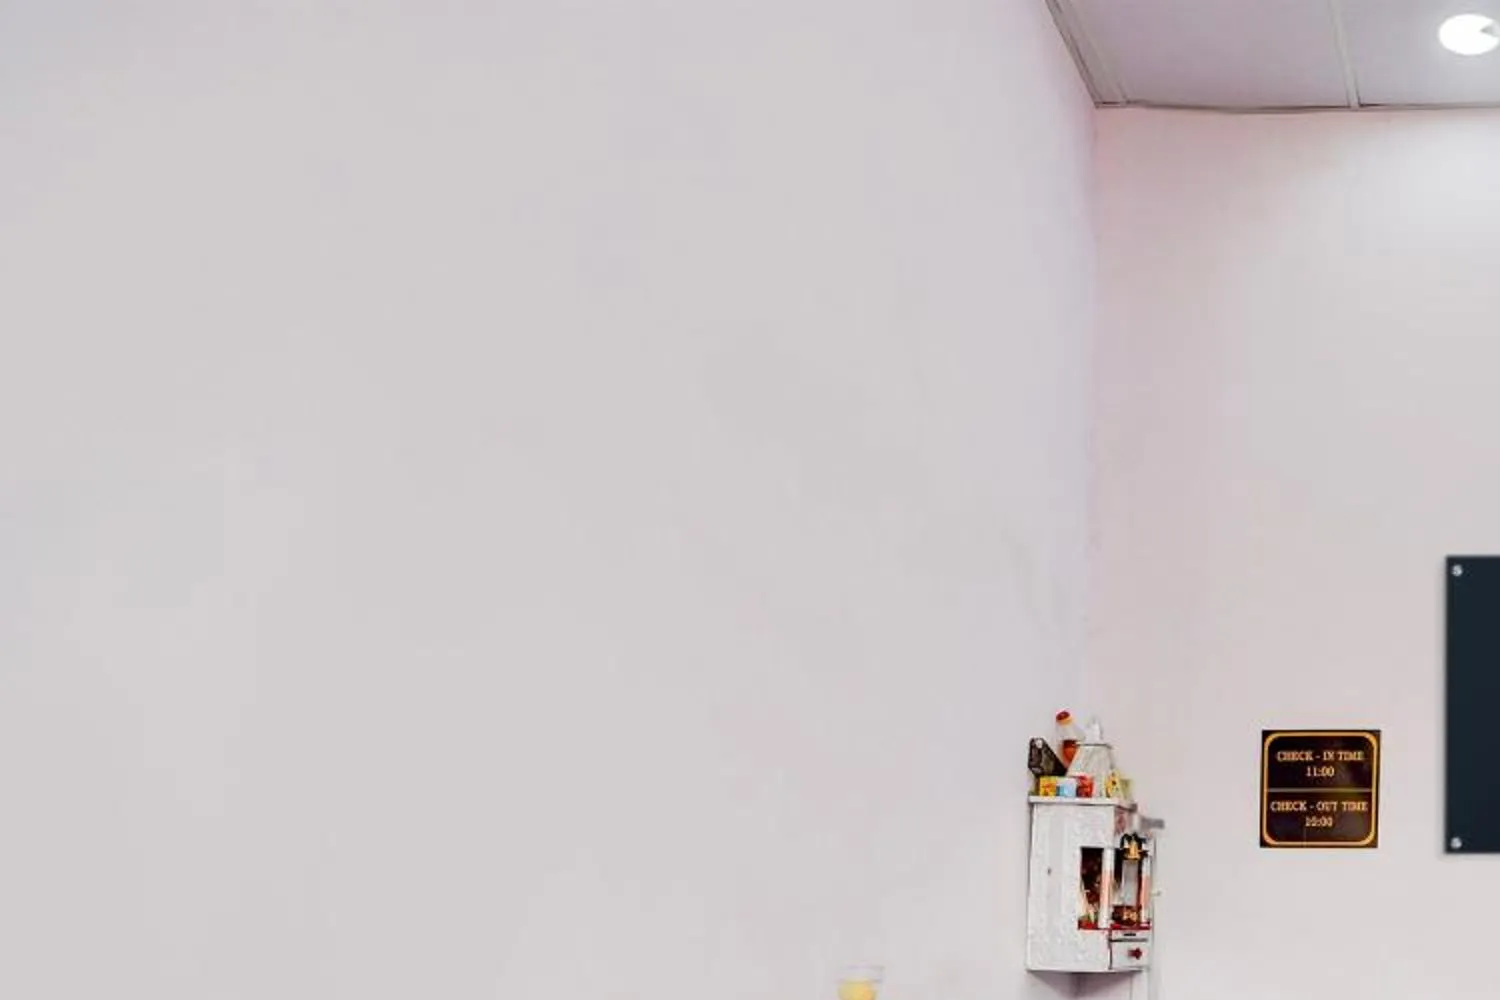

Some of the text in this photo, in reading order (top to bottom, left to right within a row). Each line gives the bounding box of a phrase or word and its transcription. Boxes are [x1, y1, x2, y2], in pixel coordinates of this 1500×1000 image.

[1277, 750, 1314, 761] CHECK
[1323, 750, 1335, 761] IN
[1338, 750, 1365, 761] TIME
[1305, 766, 1335, 777] 11:00
[1270, 801, 1307, 811] CHECK
[1316, 801, 1338, 811] OUT
[1341, 801, 1369, 811] TIME
